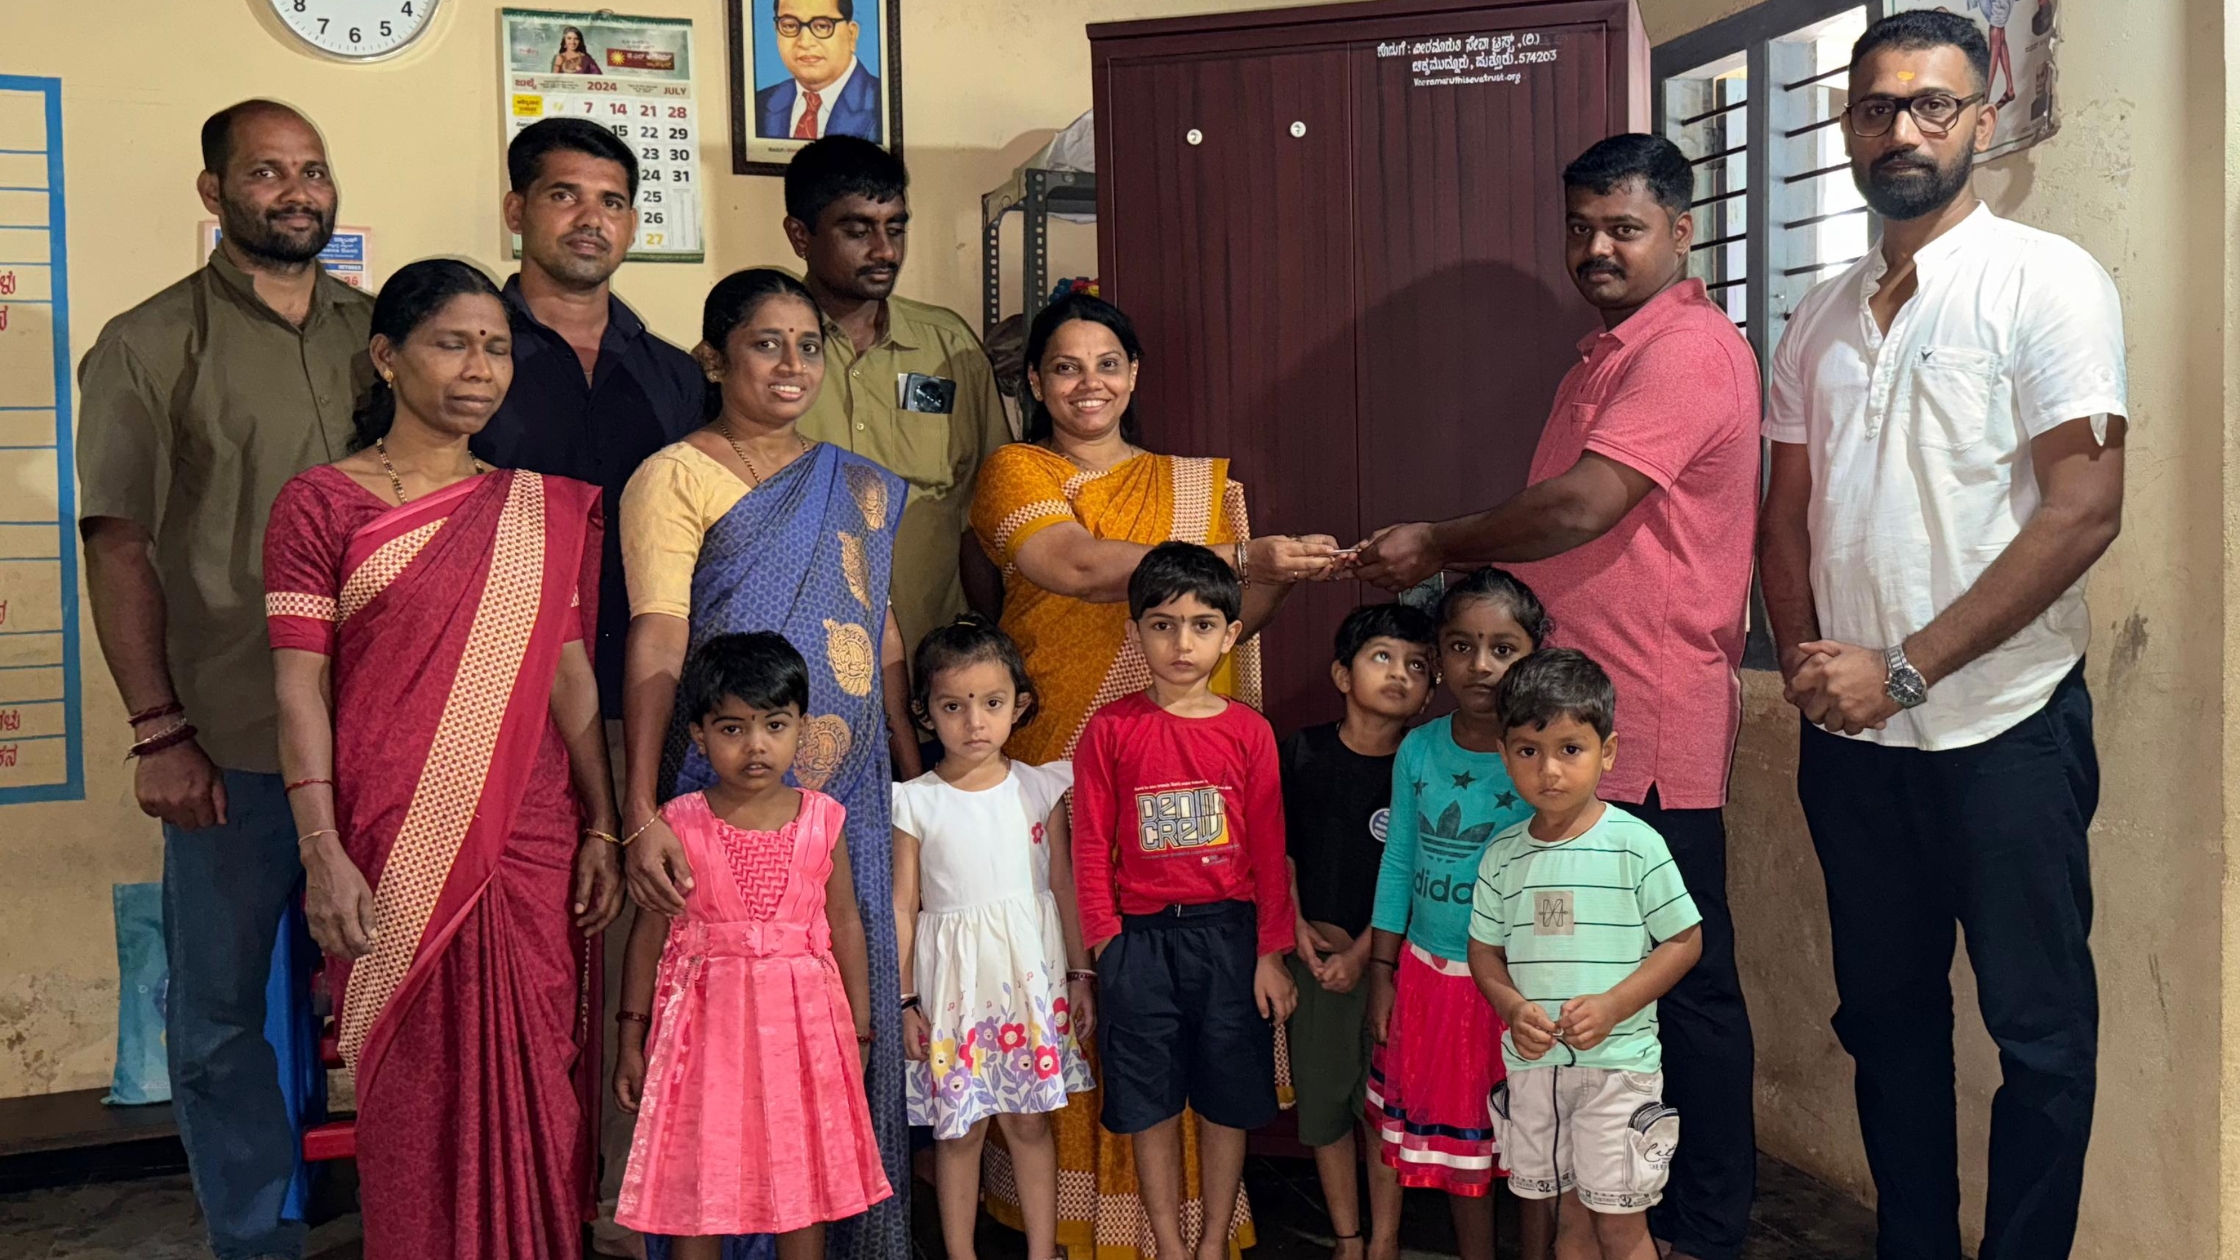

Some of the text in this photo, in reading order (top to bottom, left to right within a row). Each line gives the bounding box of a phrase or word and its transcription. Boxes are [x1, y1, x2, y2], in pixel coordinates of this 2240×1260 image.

[294, 0, 306, 12] 8
[401, 1, 413, 17] 4
[317, 18, 330, 35] 7
[380, 21, 392, 37] 5
[349, 27, 361, 43] 6
[1466, 35, 1489, 52] ಸೇವಾ
[587, 81, 618, 92] 2024
[663, 87, 687, 96] JULY
[584, 102, 688, 119] 7 14 21 28
[611, 125, 689, 140] 15 22 29
[642, 148, 690, 161] 23 30
[641, 169, 690, 182] 24 31
[643, 191, 662, 203] 25
[644, 212, 664, 224] 26
[645, 233, 664, 246] 27
[1619, 1194, 1633, 1208] 32
